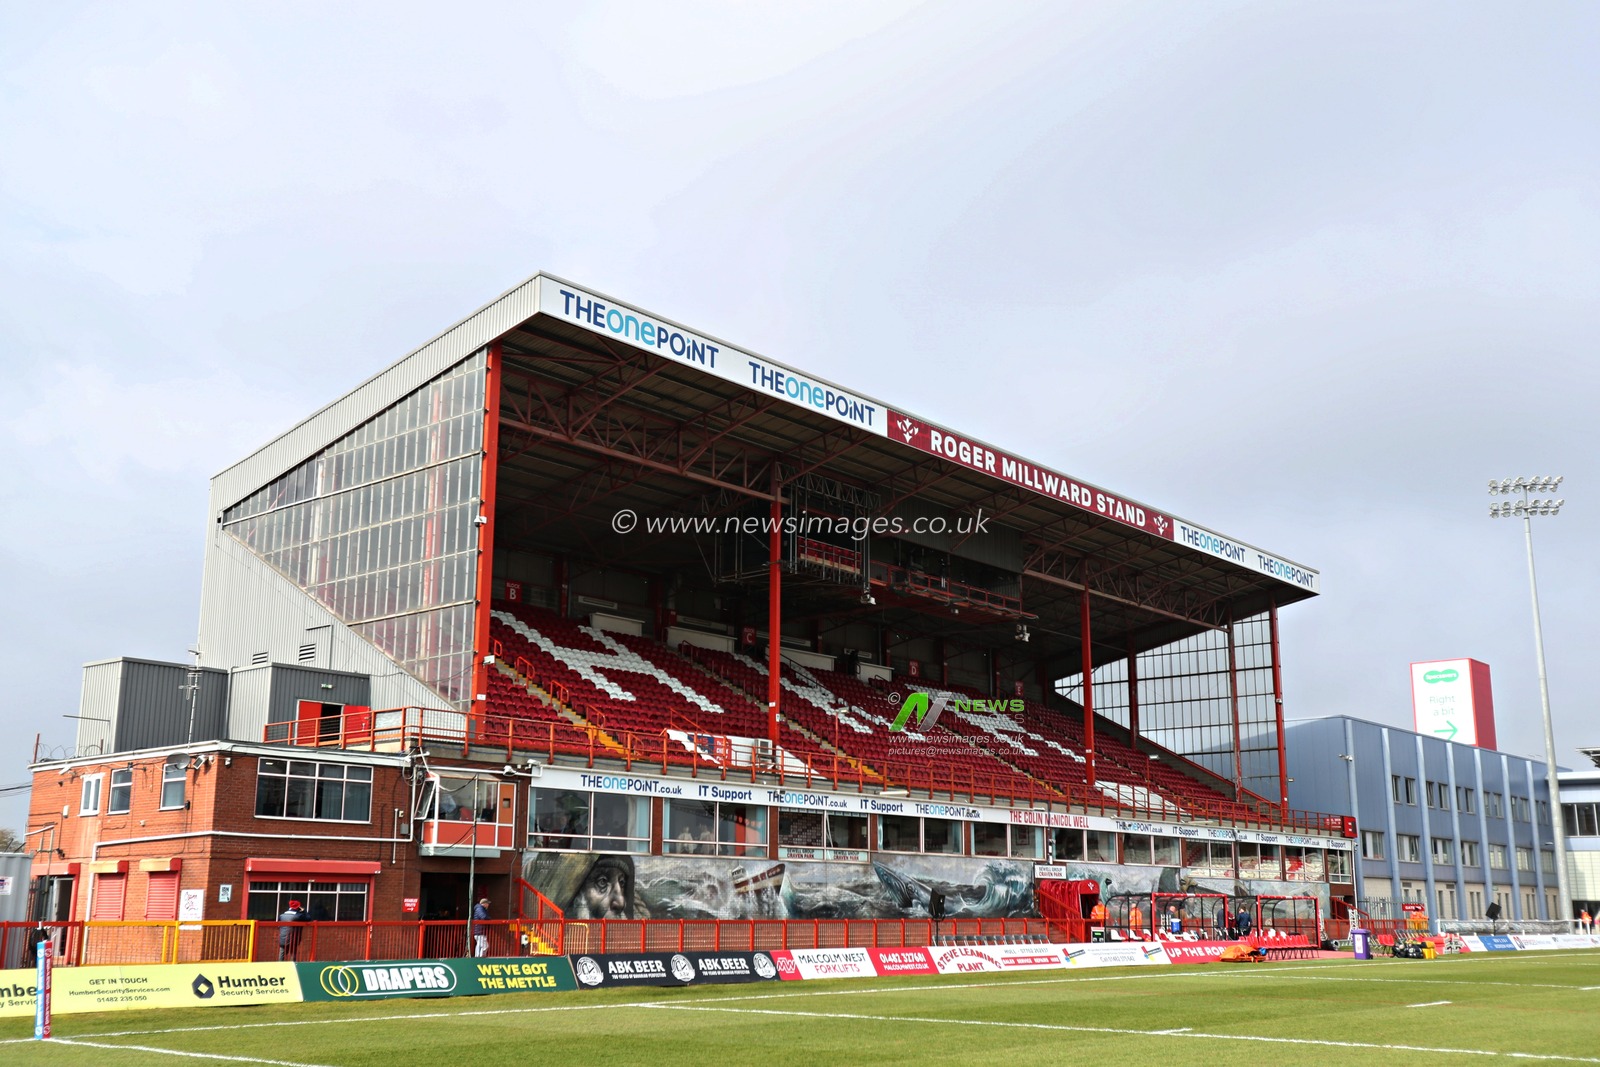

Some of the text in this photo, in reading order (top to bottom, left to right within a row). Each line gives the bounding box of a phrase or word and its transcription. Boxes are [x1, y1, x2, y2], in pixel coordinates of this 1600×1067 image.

[930, 429, 1146, 527] ROGER MILLWARD STAND
[510, 588, 516, 600] B
[746, 632, 752, 643] C
[912, 666, 916, 675] D
[1430, 696, 1456, 705] Right
[1442, 708, 1455, 716] bit
[698, 785, 709, 796] IT
[712, 786, 752, 801] Support
[860, 799, 869, 809] IT
[871, 800, 903, 813] Support
[1010, 810, 1022, 823] THE
[1024, 812, 1042, 825] COLIN
[1073, 816, 1089, 828] WELL
[1178, 827, 1198, 836] Support
[1262, 834, 1278, 844] Support
[1166, 946, 1226, 958] UP THE ROB
[699, 958, 749, 971] ABK BEER
[798, 953, 866, 964] MALCOLM WEST
[937, 948, 1002, 970] STEVE LEAMING
[477, 963, 548, 976] WE'VE GOT
[608, 960, 666, 974] ABK BEER
[814, 964, 860, 974] FORKLIFTS
[957, 962, 985, 972] PLANT
[217, 975, 286, 988] Humber
[362, 966, 449, 991] DRAPERS
[478, 976, 557, 989] THE METTLE
[0, 984, 38, 997] mbe
[69, 987, 170, 996] HumberSecurityServices.com
